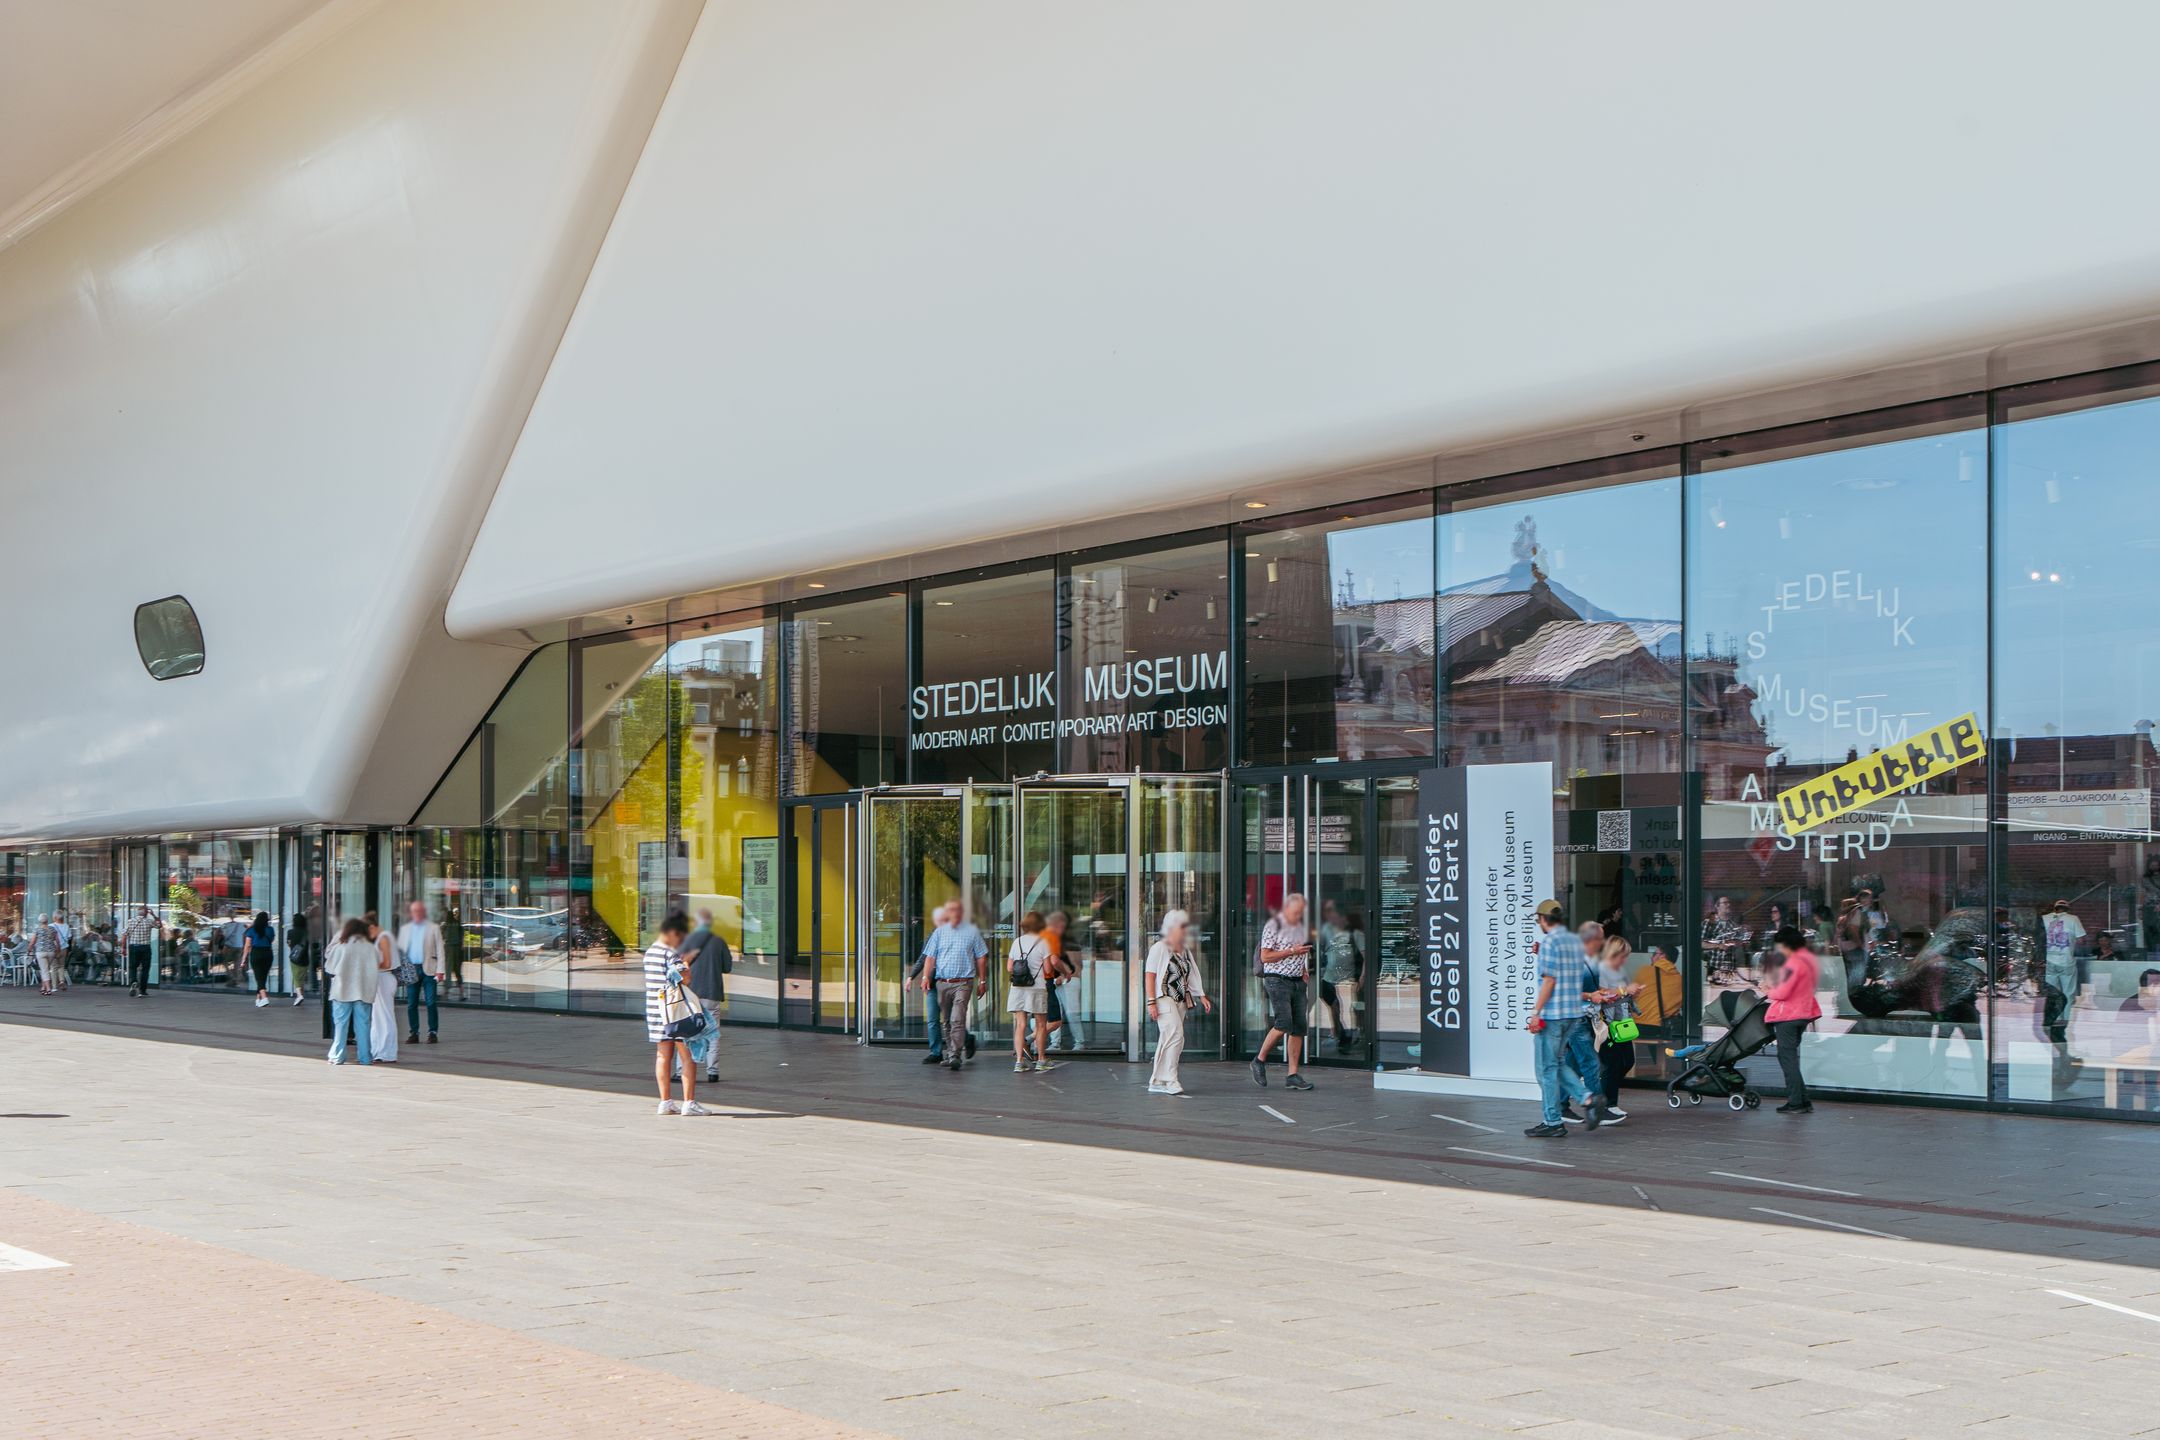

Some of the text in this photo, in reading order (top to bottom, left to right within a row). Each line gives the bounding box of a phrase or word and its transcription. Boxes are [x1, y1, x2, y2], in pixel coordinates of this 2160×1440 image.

[1748, 570, 1915, 660] STEDELIJK
[912, 651, 1227, 720] STEDELIJK MUSEUM
[1757, 673, 1908, 744] MUSEUM
[912, 705, 1227, 750] MODERN ART CONTEMPORARY ART DESIGN
[1443, 812, 1458, 830] 2
[2008, 793, 2117, 805] RDEROBE CLOAKROOM
[1443, 839, 1459, 901] Part
[2034, 832, 2128, 841] INGANG ENTRANCE
[1521, 840, 1533, 907] Museum
[1426, 814, 1442, 1028] Anselm Kiefer
[1444, 932, 1459, 950] 2
[1486, 867, 1499, 1030] Follow Anselm Kiefer
[1503, 811, 1518, 1031] from the Van Gogh Museum
[1521, 911, 1536, 980] Stedelijk
[1444, 960, 1461, 1029] Deel
[1522, 985, 1535, 1011] the
